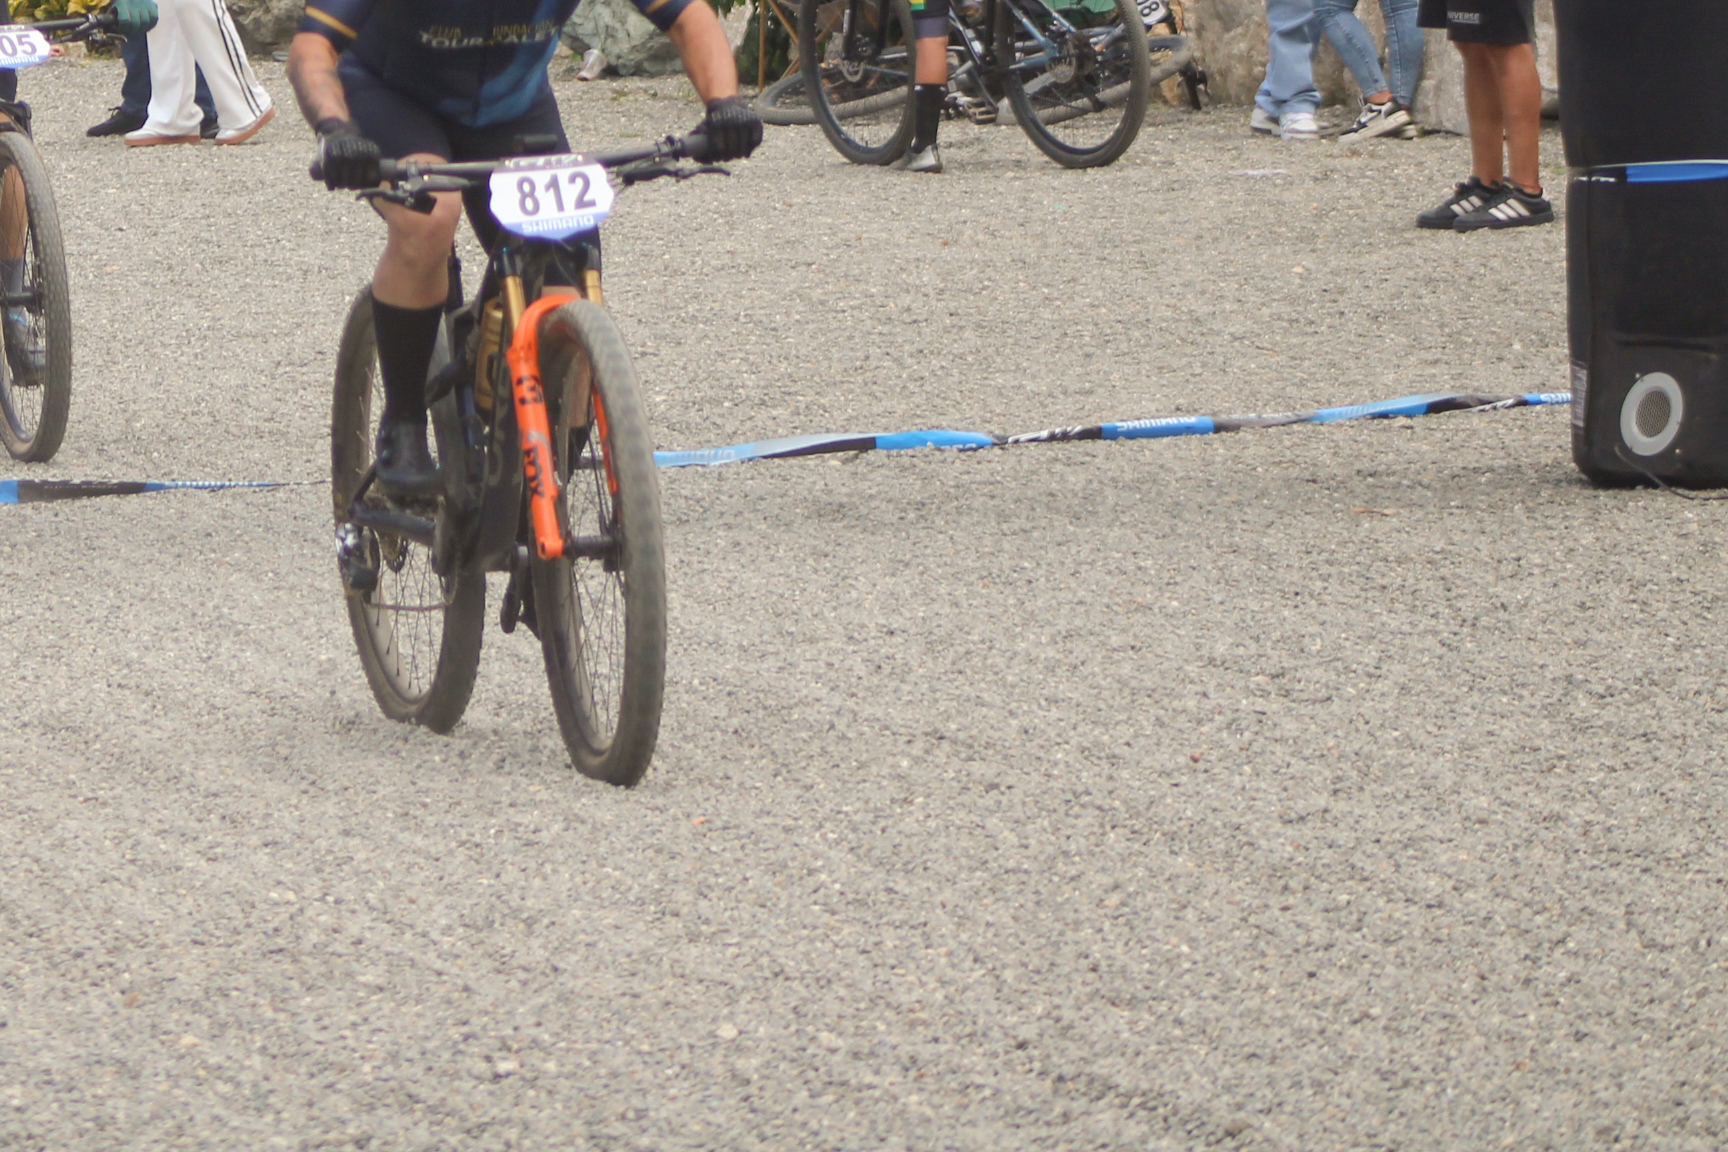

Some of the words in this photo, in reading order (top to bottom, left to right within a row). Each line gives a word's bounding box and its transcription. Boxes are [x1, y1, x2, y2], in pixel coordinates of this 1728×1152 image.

[516, 170, 598, 217] 812
[521, 214, 595, 234] SHIMANO
[1116, 416, 1197, 432] SHIMANO
